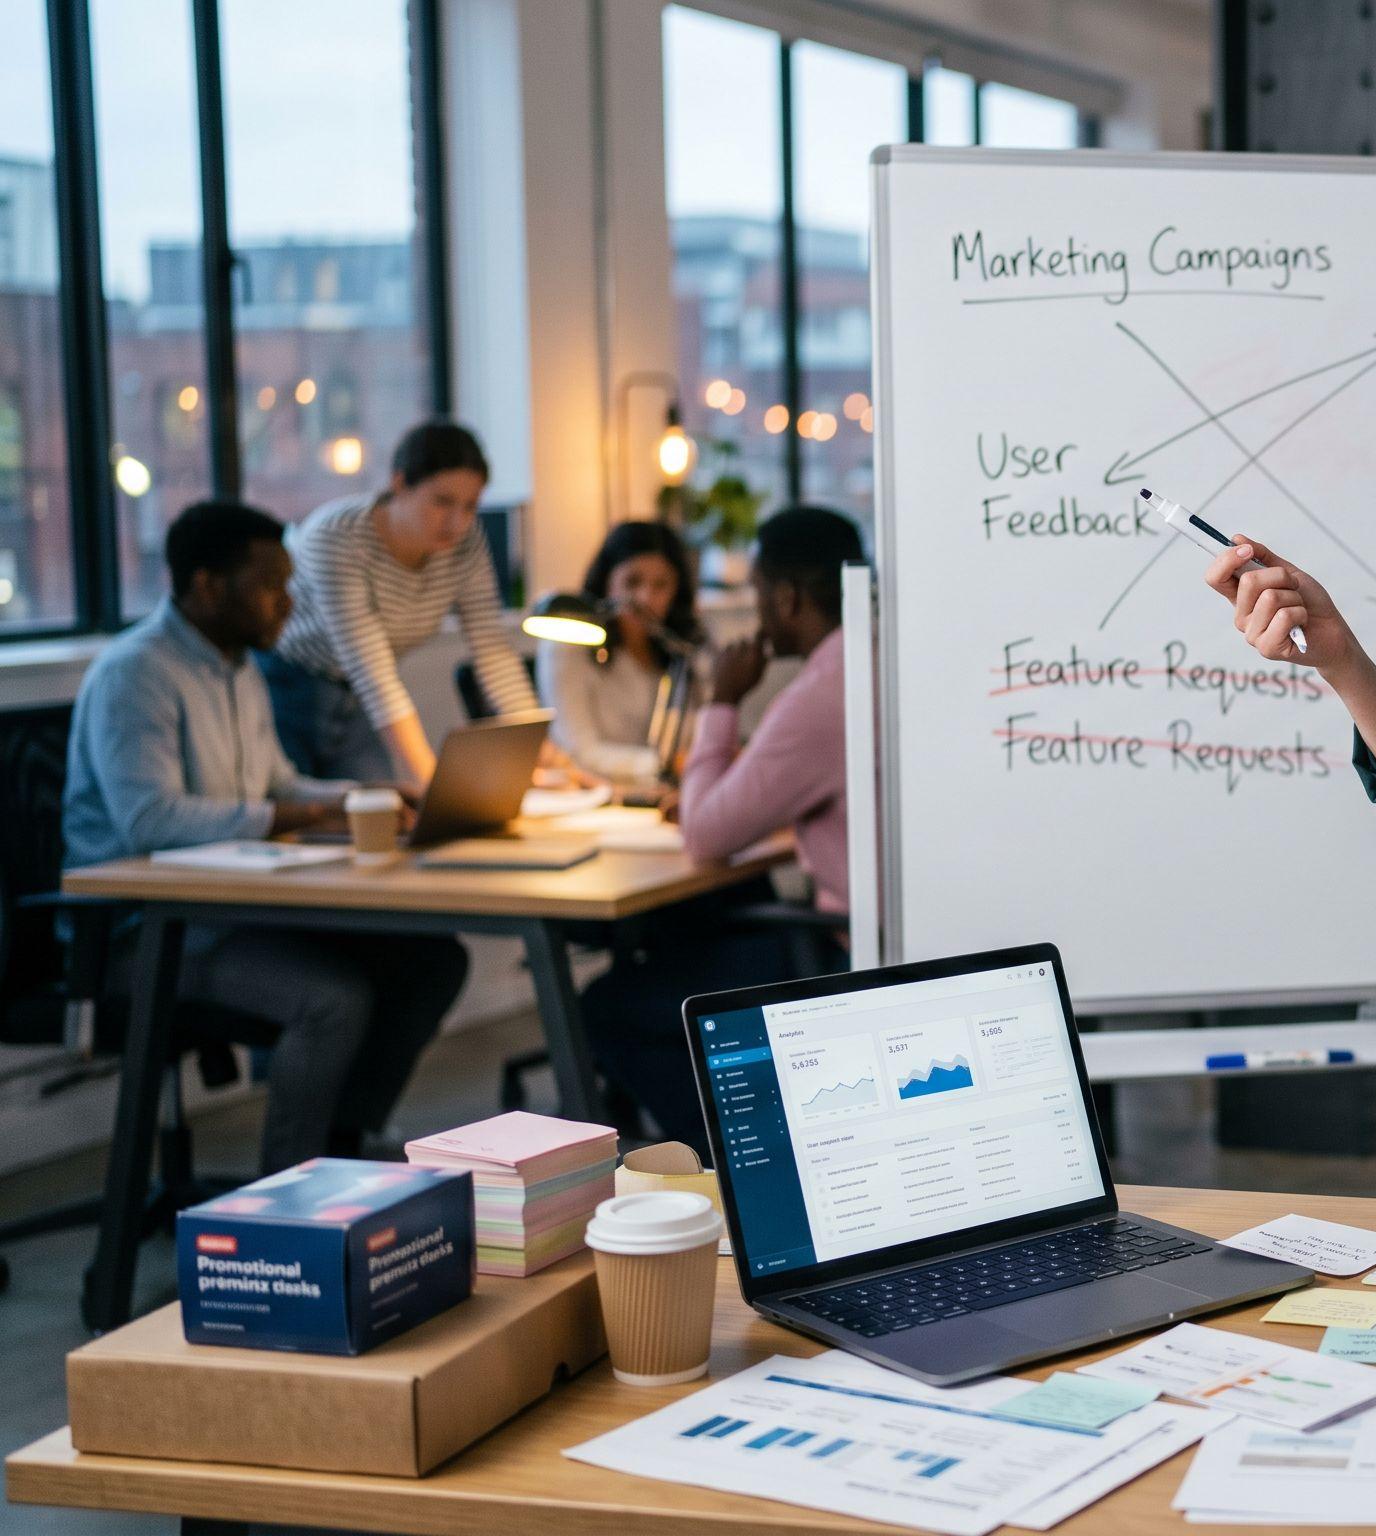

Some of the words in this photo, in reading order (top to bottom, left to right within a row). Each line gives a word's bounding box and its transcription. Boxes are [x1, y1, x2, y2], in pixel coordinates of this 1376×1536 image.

[952, 229, 1128, 305] Marketing
[1149, 226, 1332, 290] Campaigns
[977, 432, 1078, 480] User
[982, 494, 1159, 540] Feedback
[1003, 637, 1143, 690] Feature
[1163, 640, 1324, 715] Requests
[1002, 711, 1148, 771] Feature
[1166, 718, 1330, 795] Requests
[197, 1254, 301, 1279] Promotional
